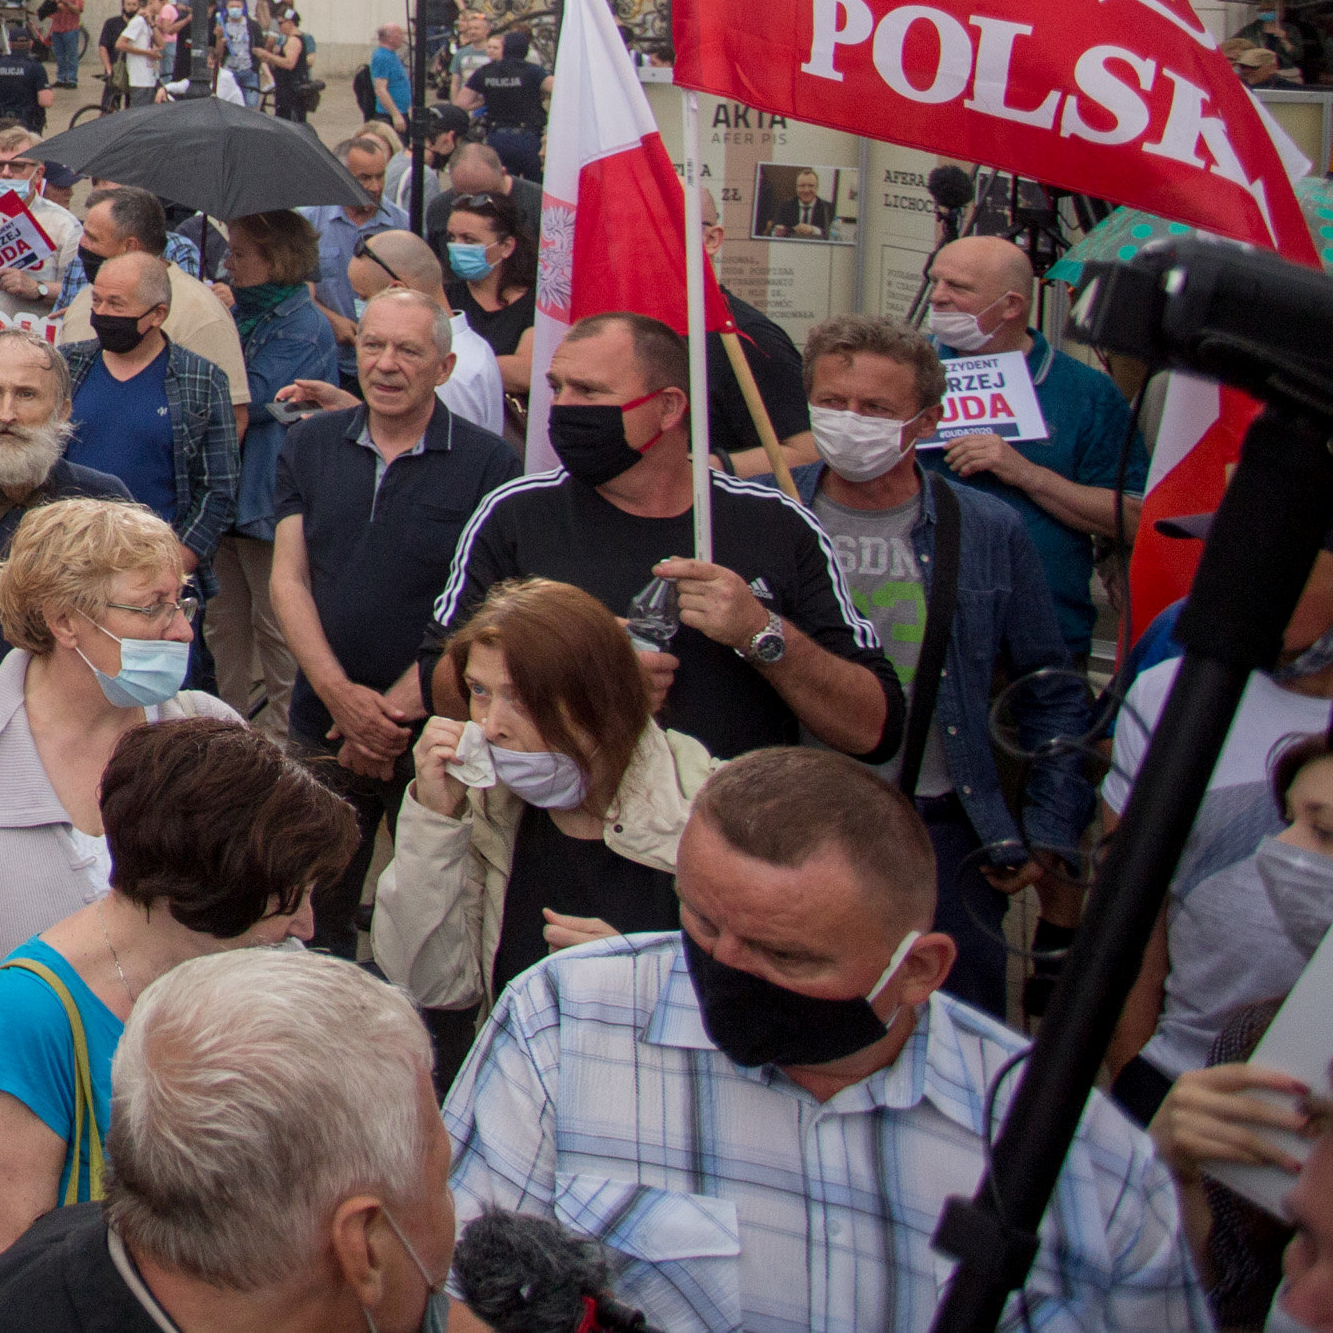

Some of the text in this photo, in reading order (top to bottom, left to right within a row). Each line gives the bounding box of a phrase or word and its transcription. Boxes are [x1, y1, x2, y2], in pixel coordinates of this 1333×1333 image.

[711, 132, 788, 146] AFER PIS
[883, 193, 938, 214] LICHOC
[941, 393, 1015, 422] UDA
